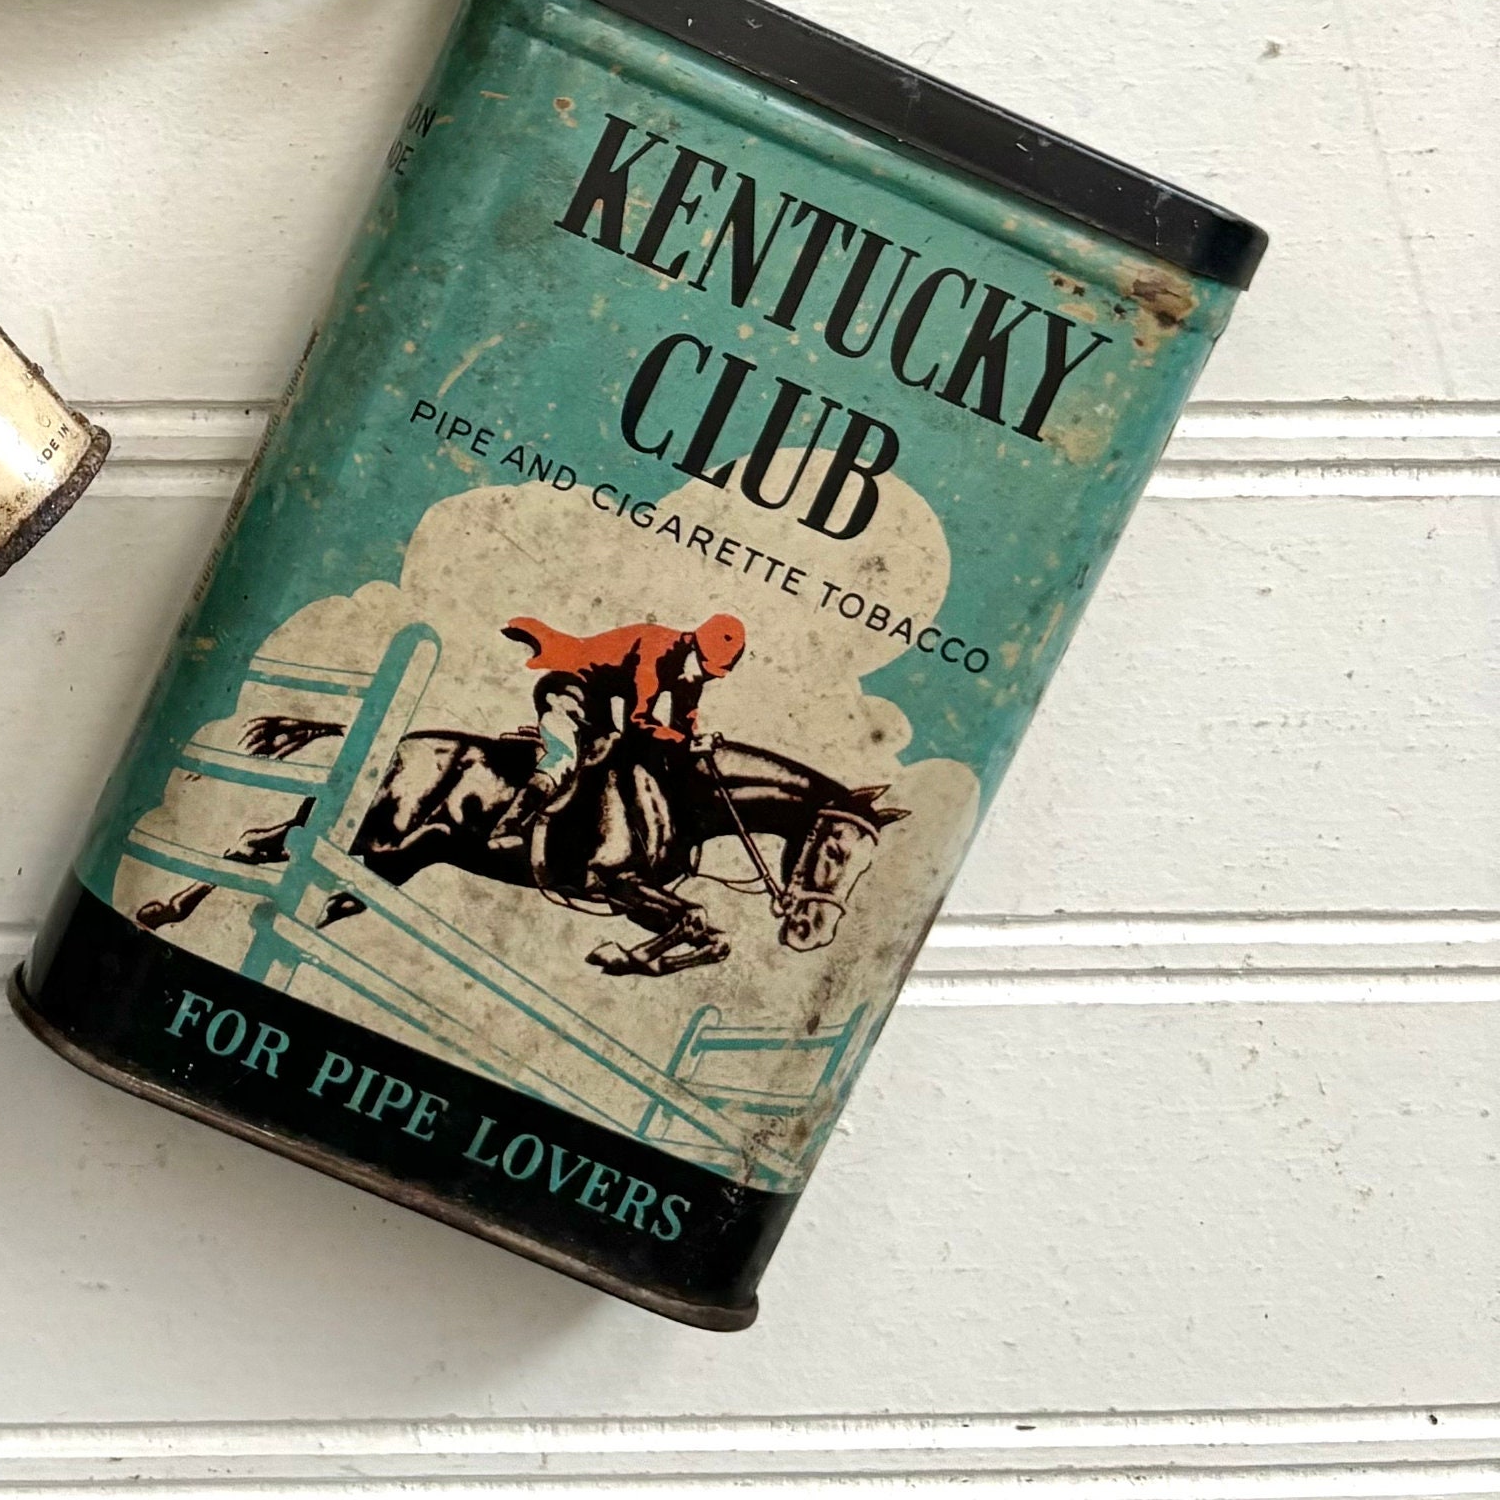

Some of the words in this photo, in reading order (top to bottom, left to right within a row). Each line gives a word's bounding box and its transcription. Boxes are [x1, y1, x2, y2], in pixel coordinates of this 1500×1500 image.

[553, 113, 1112, 442] KENTUCKY
[410, 399, 496, 458] PIPE
[501, 445, 577, 493] AND
[591, 483, 808, 596] CIGARETTE
[821, 580, 990, 674] TOBACCO
[620, 333, 901, 541] CLUB
[165, 989, 291, 1079] FOR
[307, 1050, 450, 1142] PIPE
[462, 1115, 691, 1241] LOVERS
